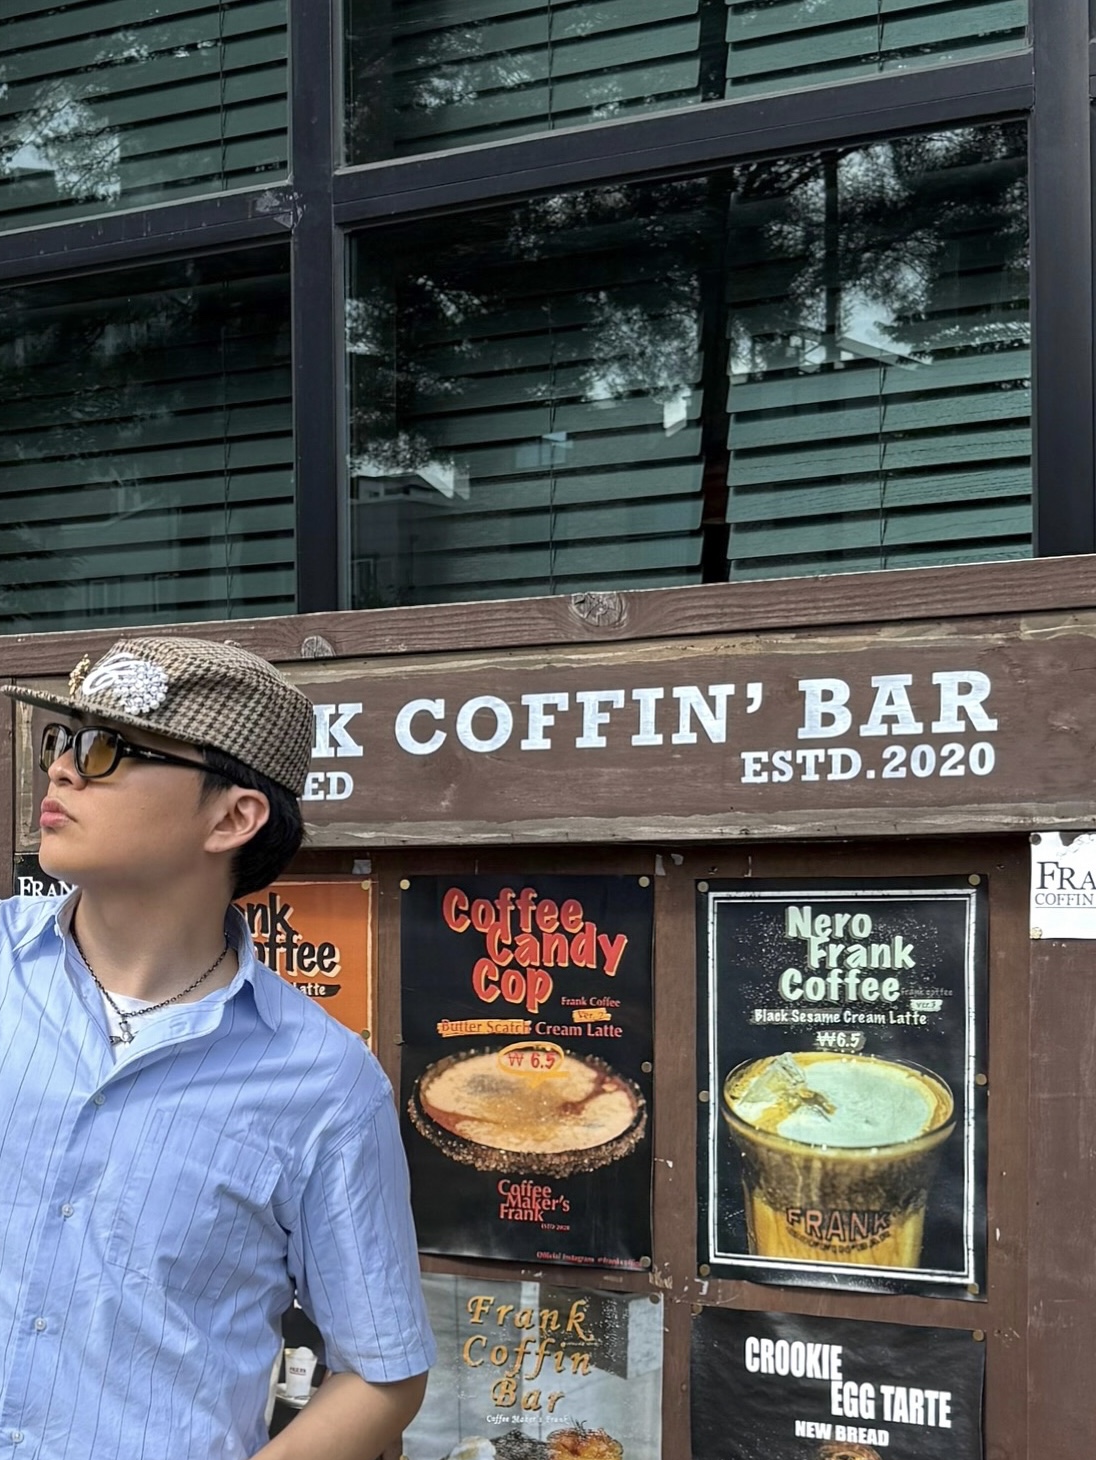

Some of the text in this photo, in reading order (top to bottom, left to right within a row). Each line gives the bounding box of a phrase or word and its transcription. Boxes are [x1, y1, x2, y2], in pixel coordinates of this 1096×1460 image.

[394, 682, 764, 756] COFFIN'
[797, 670, 999, 740] BAR
[740, 741, 997, 784] ESTD.2020
[235, 892, 303, 938] nk
[442, 887, 584, 944] Coffee
[1035, 893, 1094, 906] COFFIN
[785, 906, 873, 943] Nero
[486, 921, 628, 977] Candy
[807, 935, 917, 970] Frank
[294, 983, 326, 996] atte
[472, 957, 554, 1014] Cop
[561, 996, 621, 1008] Frank Coffee
[778, 967, 901, 1002] Coffee
[441, 1019, 483, 1033] Butter
[535, 1021, 583, 1037] Cream
[587, 1024, 624, 1038] Latte
[754, 1009, 928, 1026] Black Sesame Cream Latte
[530, 1052, 556, 1070] 6.5
[497, 1178, 552, 1199] Coffee
[504, 1192, 571, 1213] Maker's
[499, 1203, 544, 1222] Frank
[786, 1207, 892, 1243] FRANK
[467, 1295, 595, 1342] Frank
[463, 1334, 592, 1380] Coffin
[745, 1336, 842, 1380] CROOKIE
[490, 1376, 565, 1412] Bar
[831, 1380, 952, 1428] EGG TARTE
[795, 1420, 890, 1447] NEW BREAD
